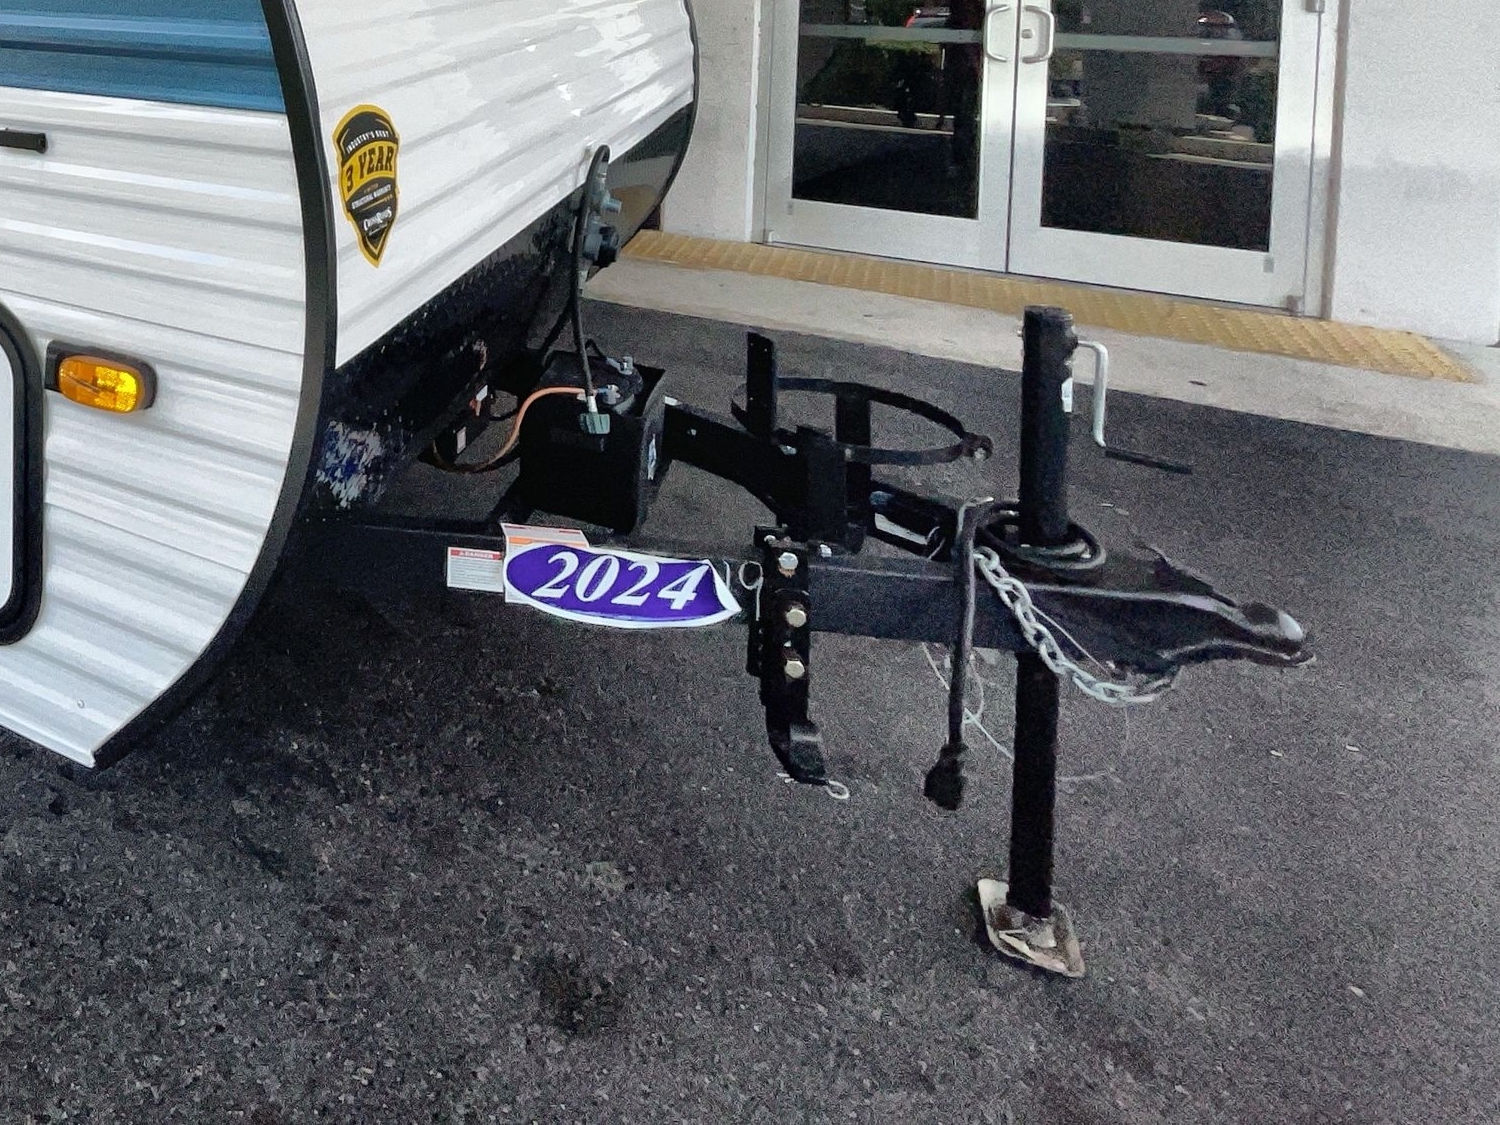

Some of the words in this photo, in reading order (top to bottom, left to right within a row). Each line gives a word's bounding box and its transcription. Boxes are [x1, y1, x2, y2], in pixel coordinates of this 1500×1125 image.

[345, 164, 354, 193] 3
[358, 145, 394, 180] YEAR
[464, 551, 494, 560] DANGER
[531, 551, 709, 610] 2024
